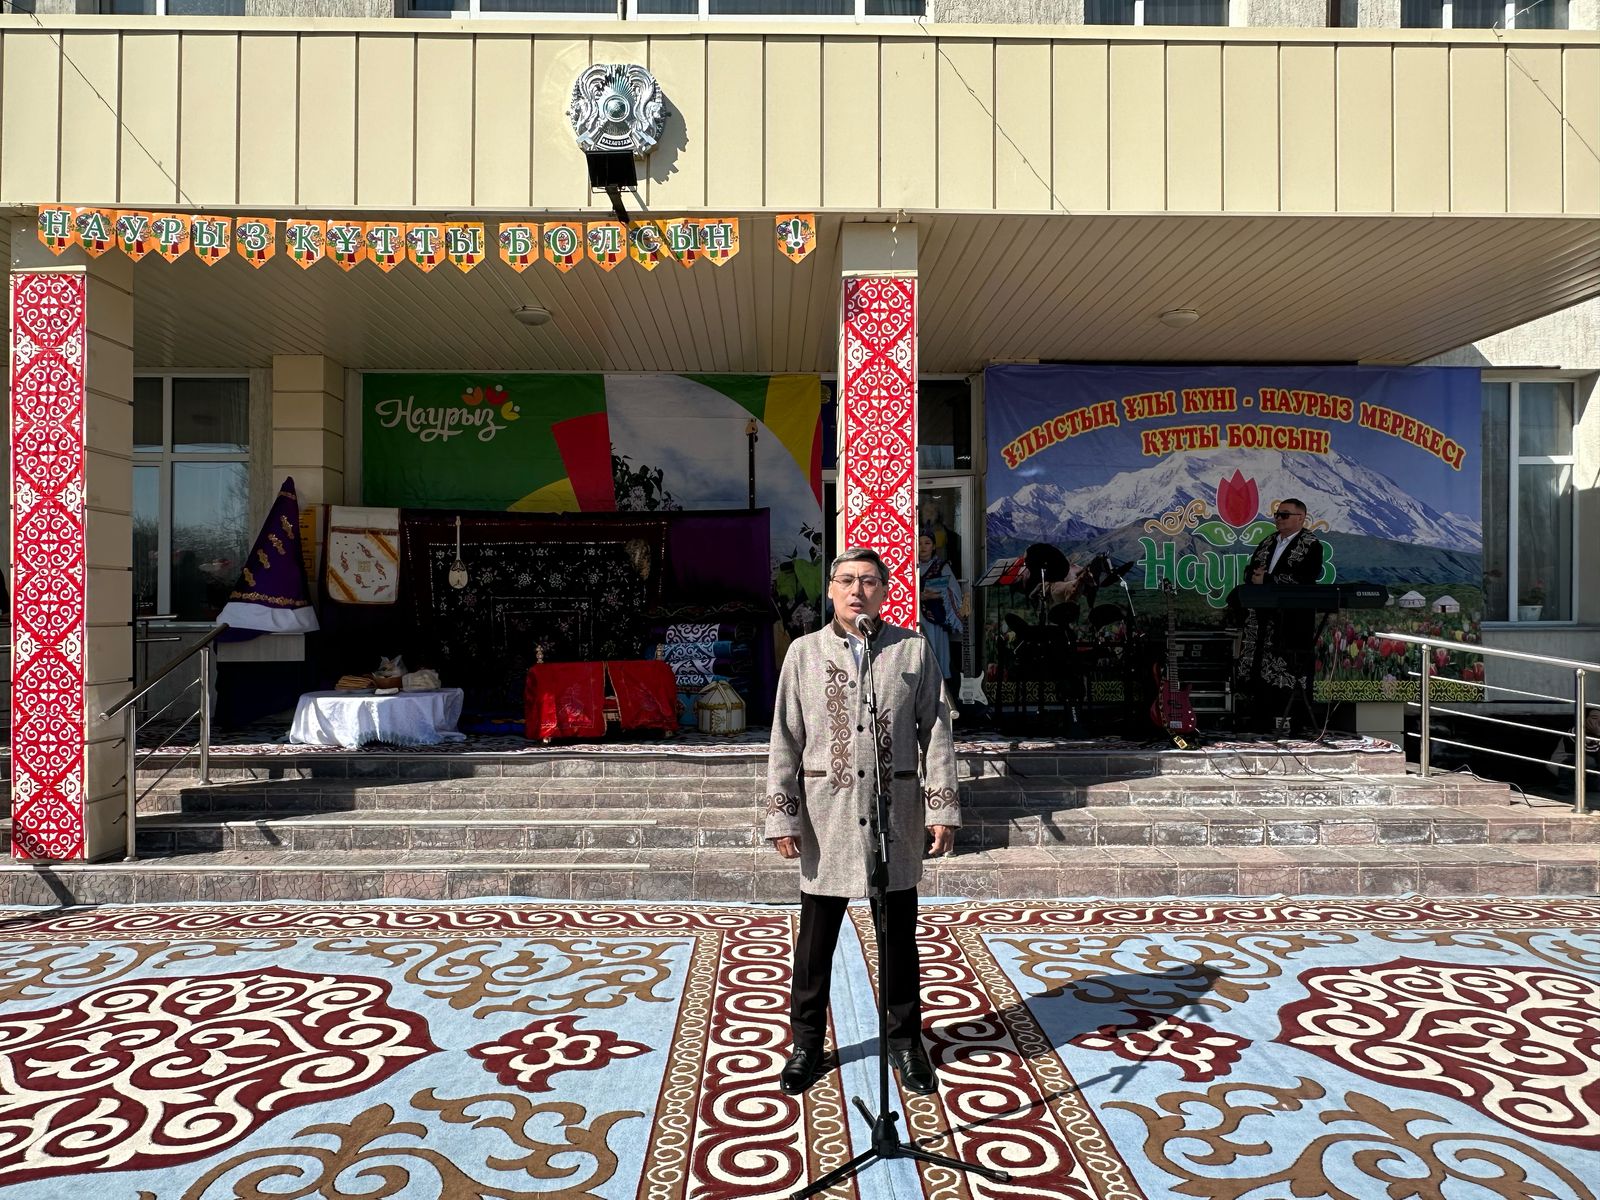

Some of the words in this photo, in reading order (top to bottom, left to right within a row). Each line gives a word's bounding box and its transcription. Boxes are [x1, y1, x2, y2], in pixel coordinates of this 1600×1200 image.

[43, 209, 267, 251] НАУРЫЗ
[292, 224, 485, 258] ҚҰТТЫ
[506, 222, 734, 257] БОЛСЫН
[375, 395, 508, 442] Наурыз
[1001, 400, 1120, 470] ҰЛЫСТЫҢ
[1122, 391, 1177, 421] ҰЛЫ
[1182, 387, 1237, 413] КҮНІ
[1259, 388, 1354, 423] НАУРЫЗ
[1359, 402, 1467, 471] МЕРЕКЕСІ
[1141, 425, 1220, 457] ҚҰТТЫ
[1227, 425, 1331, 455] БОЛСЫН!
